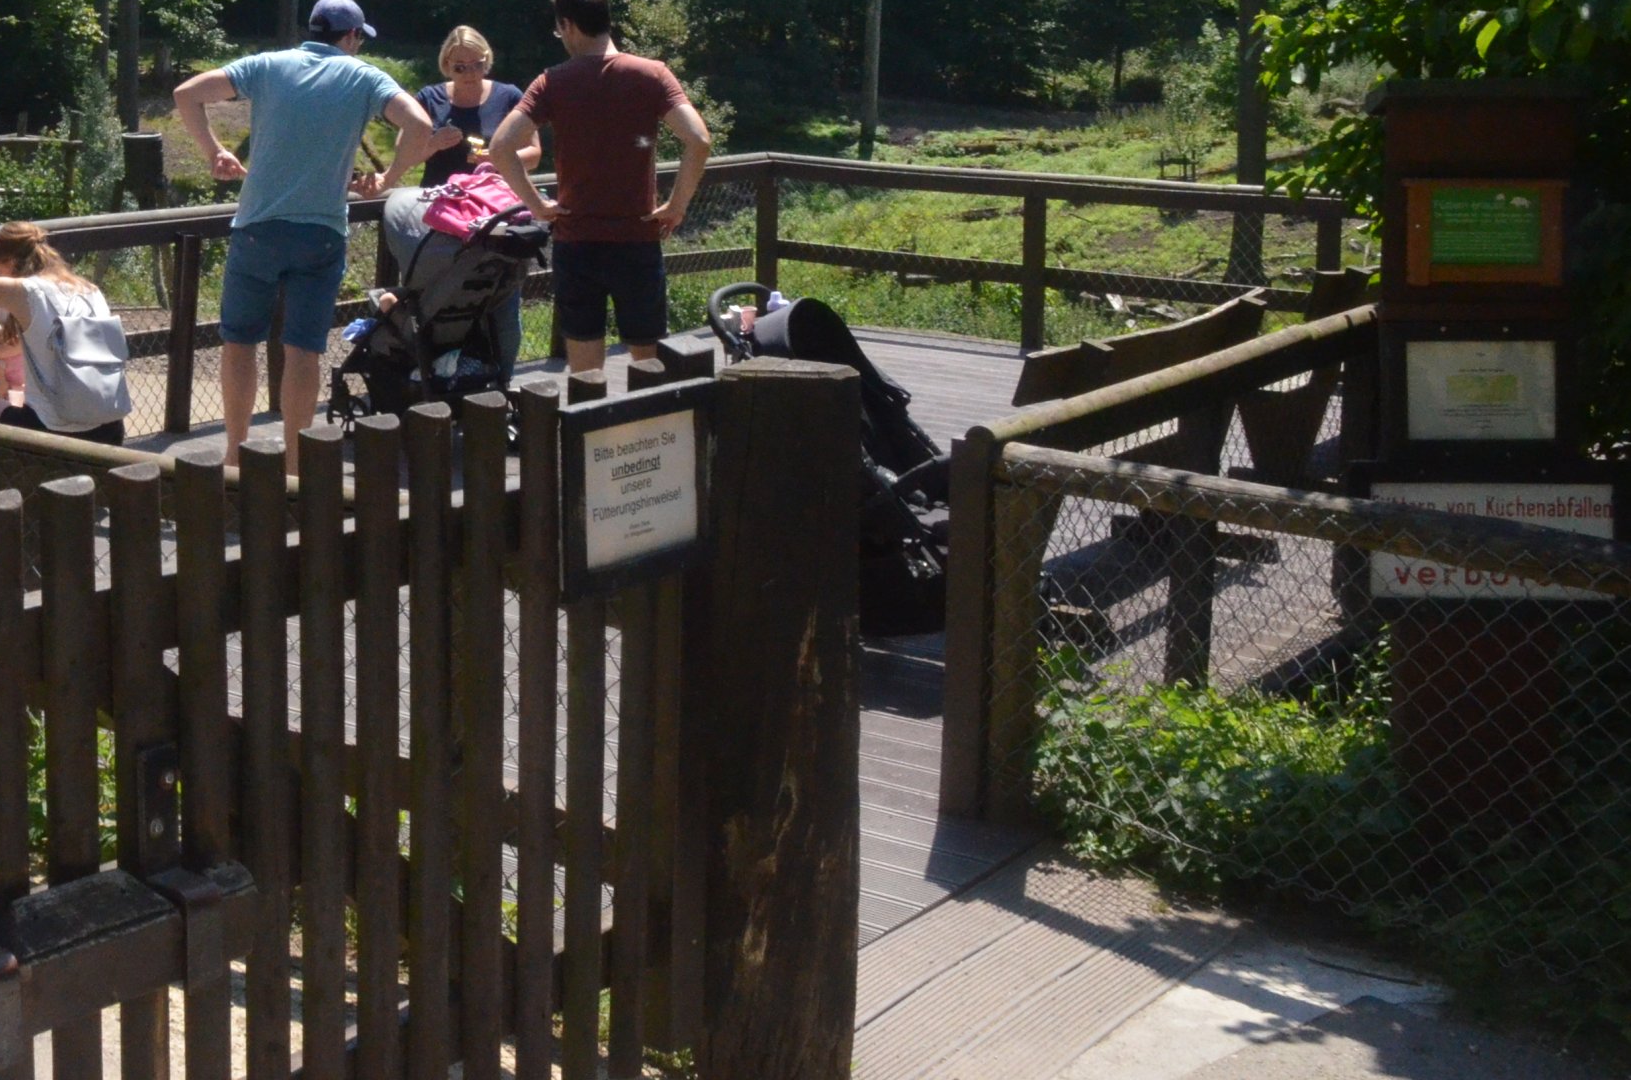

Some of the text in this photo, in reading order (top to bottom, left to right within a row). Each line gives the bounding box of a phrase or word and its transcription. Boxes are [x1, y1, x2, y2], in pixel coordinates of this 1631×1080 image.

[593, 431, 676, 462] Bitte beachten Sie
[611, 454, 661, 479] unbedingt
[620, 477, 652, 495] unsere
[592, 485, 682, 522] Fütterungshinweise!
[1446, 501, 1476, 515] von
[1394, 565, 1557, 587] verbo
